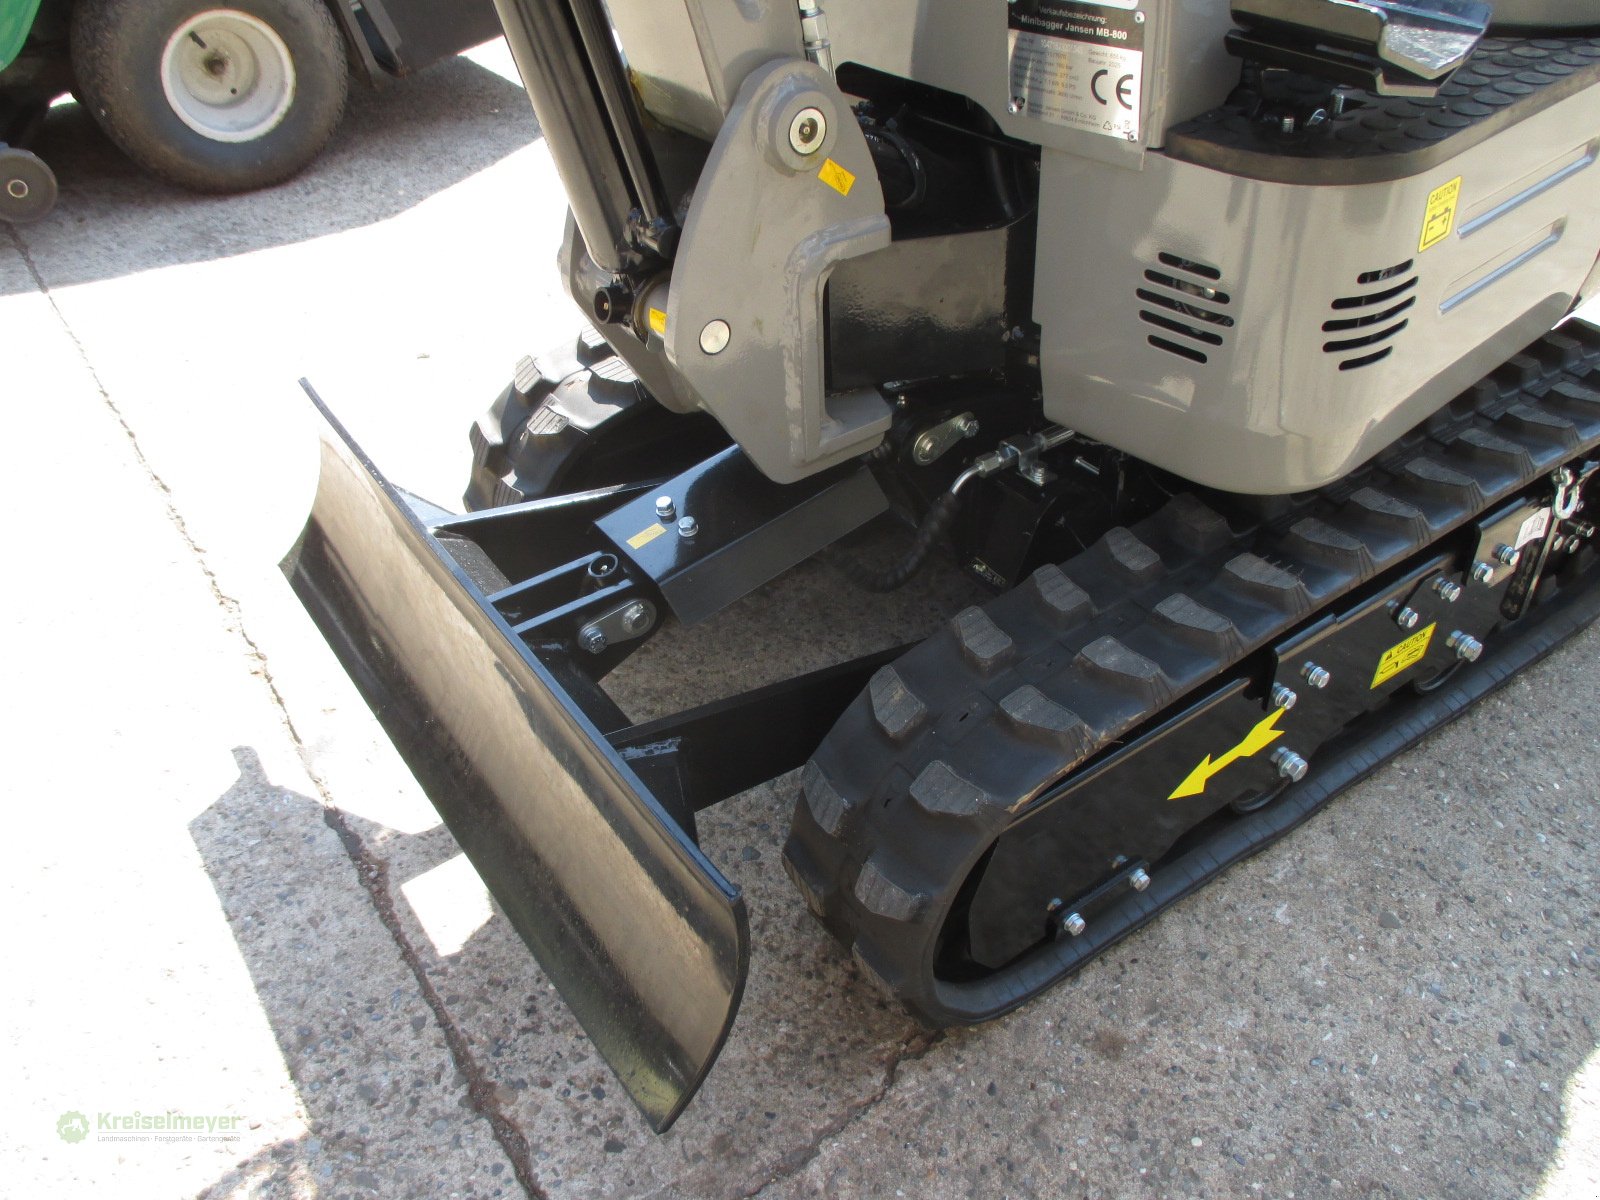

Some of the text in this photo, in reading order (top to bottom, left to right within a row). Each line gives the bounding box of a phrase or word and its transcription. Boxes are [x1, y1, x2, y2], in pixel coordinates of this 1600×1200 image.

[1021, 14, 1128, 41] Minibagger Jansen MB-800
